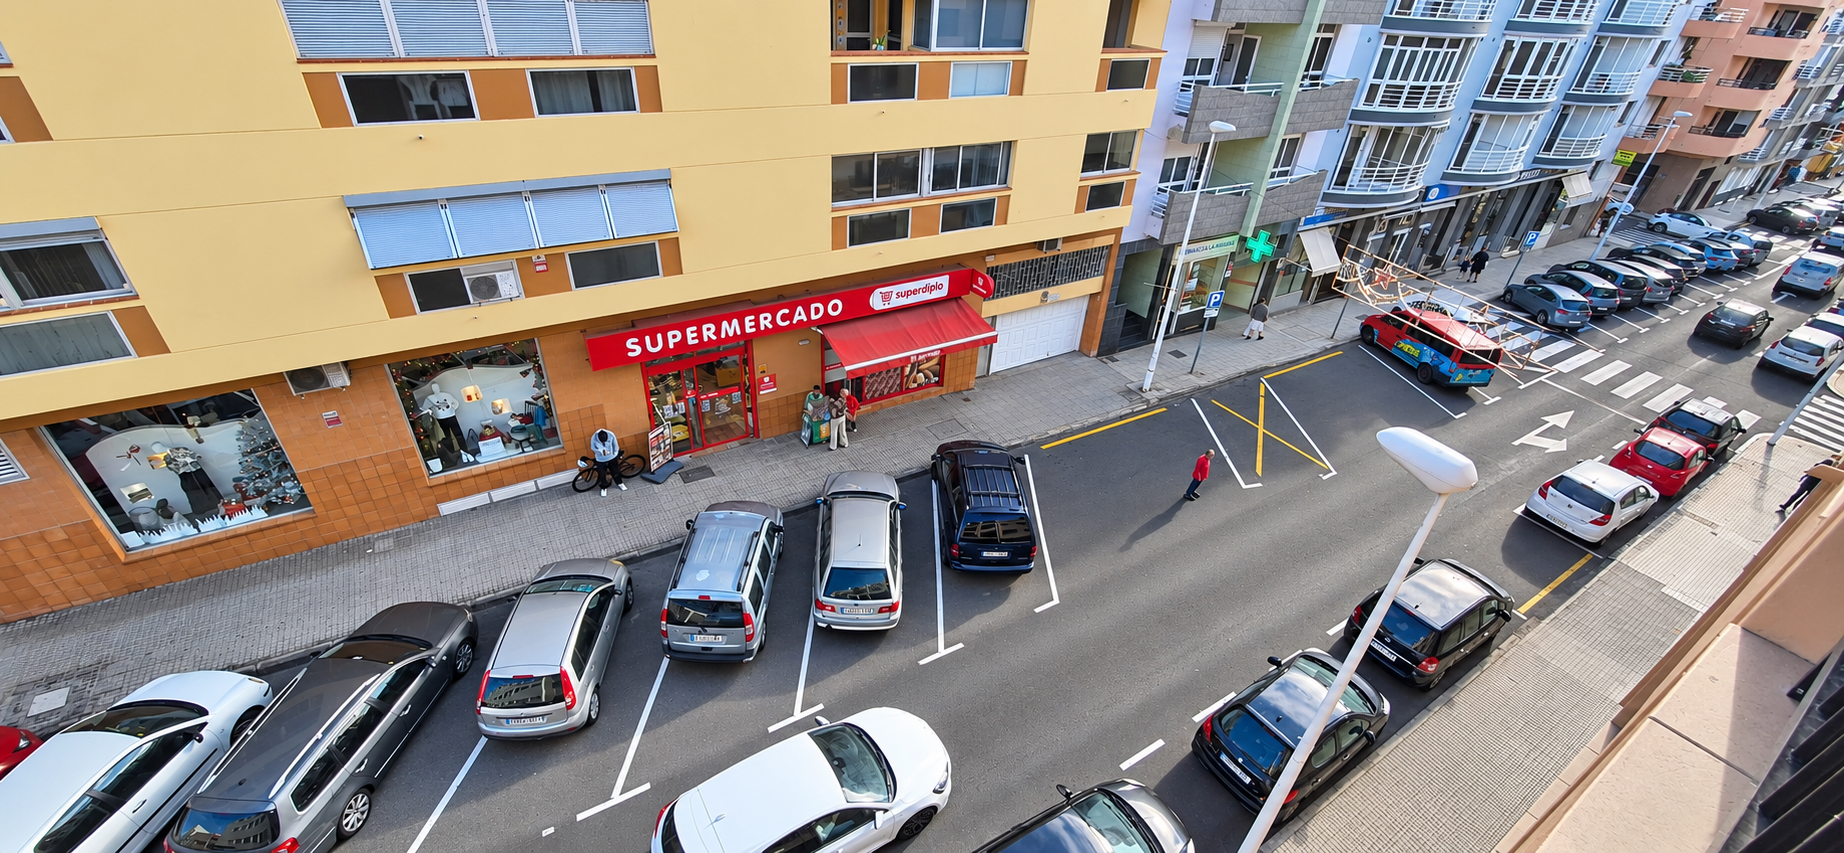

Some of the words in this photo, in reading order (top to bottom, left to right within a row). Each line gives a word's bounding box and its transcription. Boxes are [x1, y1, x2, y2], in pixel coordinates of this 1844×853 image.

[895, 281, 944, 300] superdiplo
[1210, 293, 1221, 307] P
[625, 298, 844, 358] SUPERMERCADO
